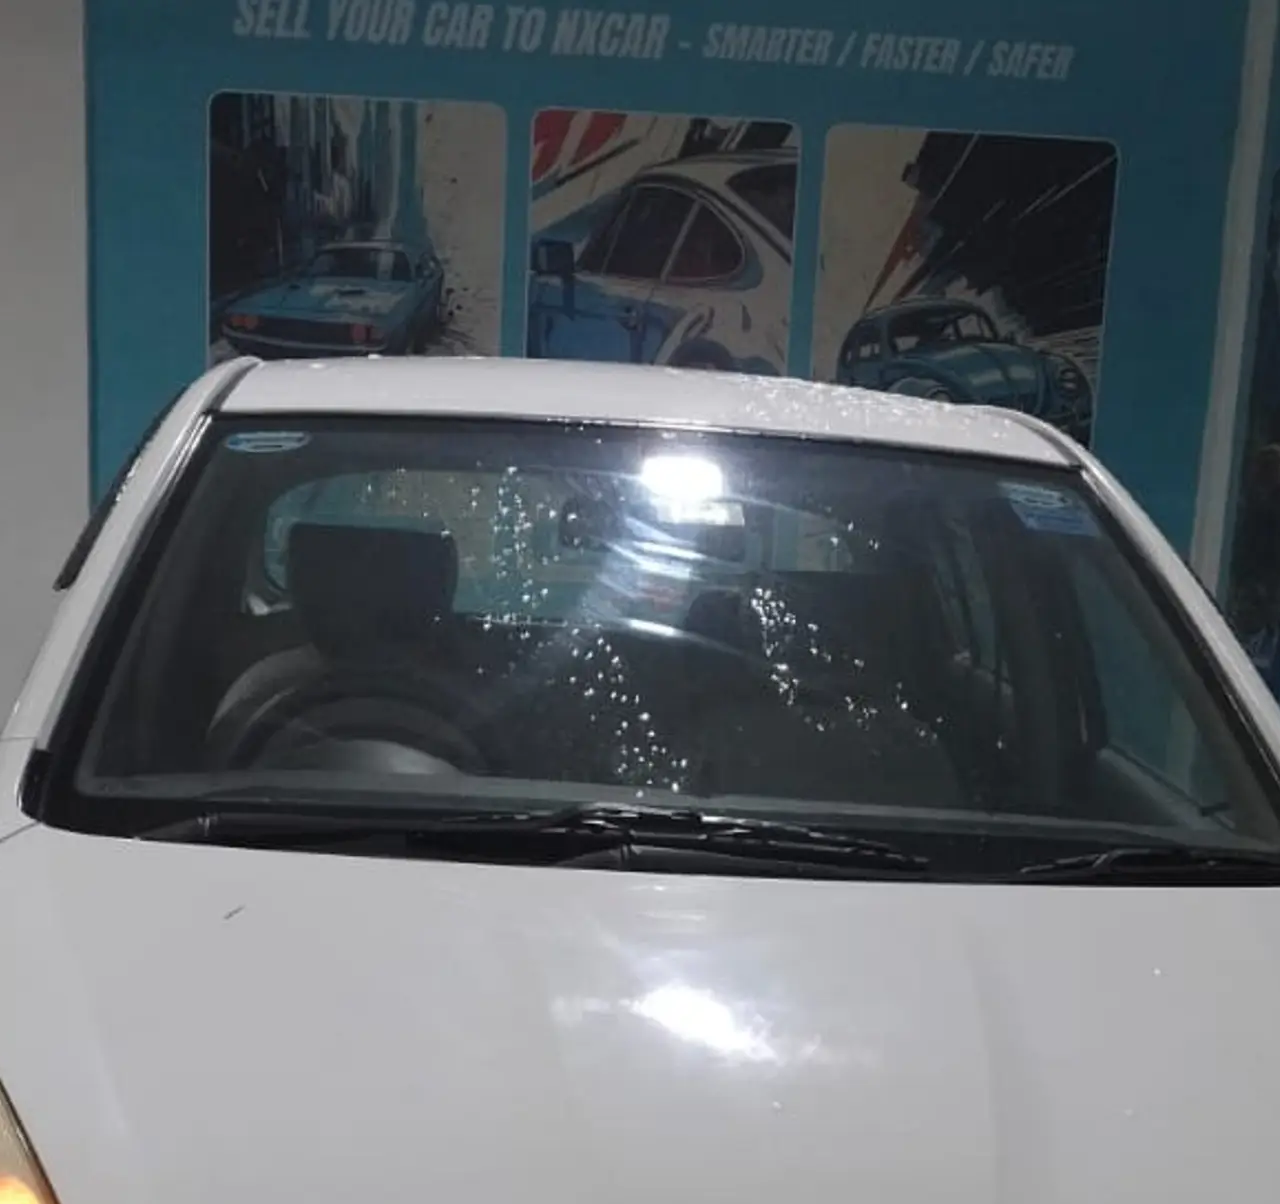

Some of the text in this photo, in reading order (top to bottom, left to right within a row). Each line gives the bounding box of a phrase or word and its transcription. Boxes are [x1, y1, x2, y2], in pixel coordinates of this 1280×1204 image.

[233, 0, 311, 38] SELL
[326, 0, 414, 45] YOUR
[423, 1, 495, 49] CAR
[502, 6, 546, 52] TO
[550, 8, 670, 60] NXCAR
[703, 22, 834, 66] SMARTER
[860, 32, 961, 75] FASTER
[987, 40, 1076, 81] SAFER
